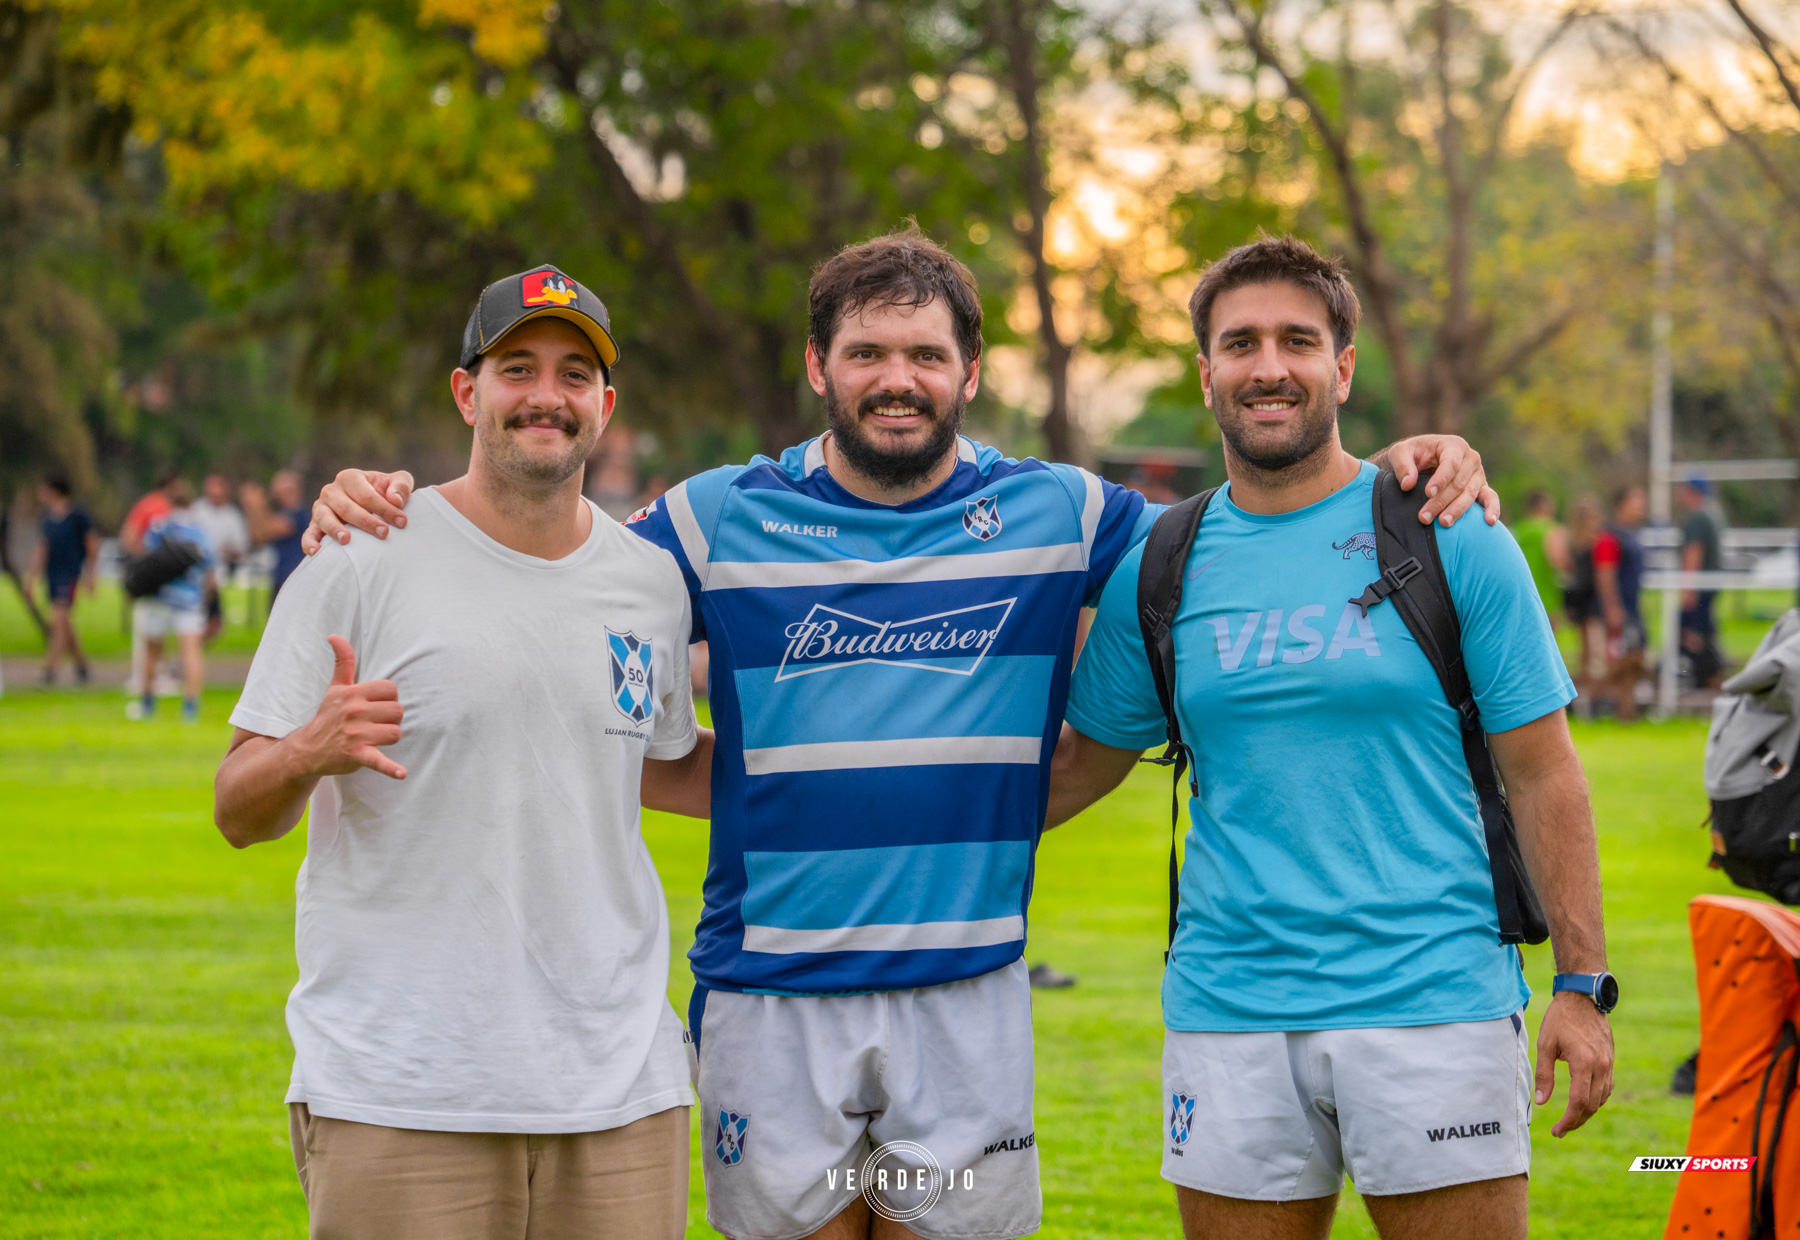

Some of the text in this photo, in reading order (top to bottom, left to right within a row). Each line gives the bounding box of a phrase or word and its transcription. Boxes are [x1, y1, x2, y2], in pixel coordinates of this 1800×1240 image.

[761, 520, 838, 538] WALKER
[784, 619, 998, 660] Budweiser
[1202, 603, 1382, 671] VISA
[628, 667, 644, 683] 50
[604, 727, 627, 737] LUJAN
[627, 730, 646, 740] RUGBY
[1426, 1121, 1501, 1143] WALKER
[984, 1131, 1035, 1156] WALKE
